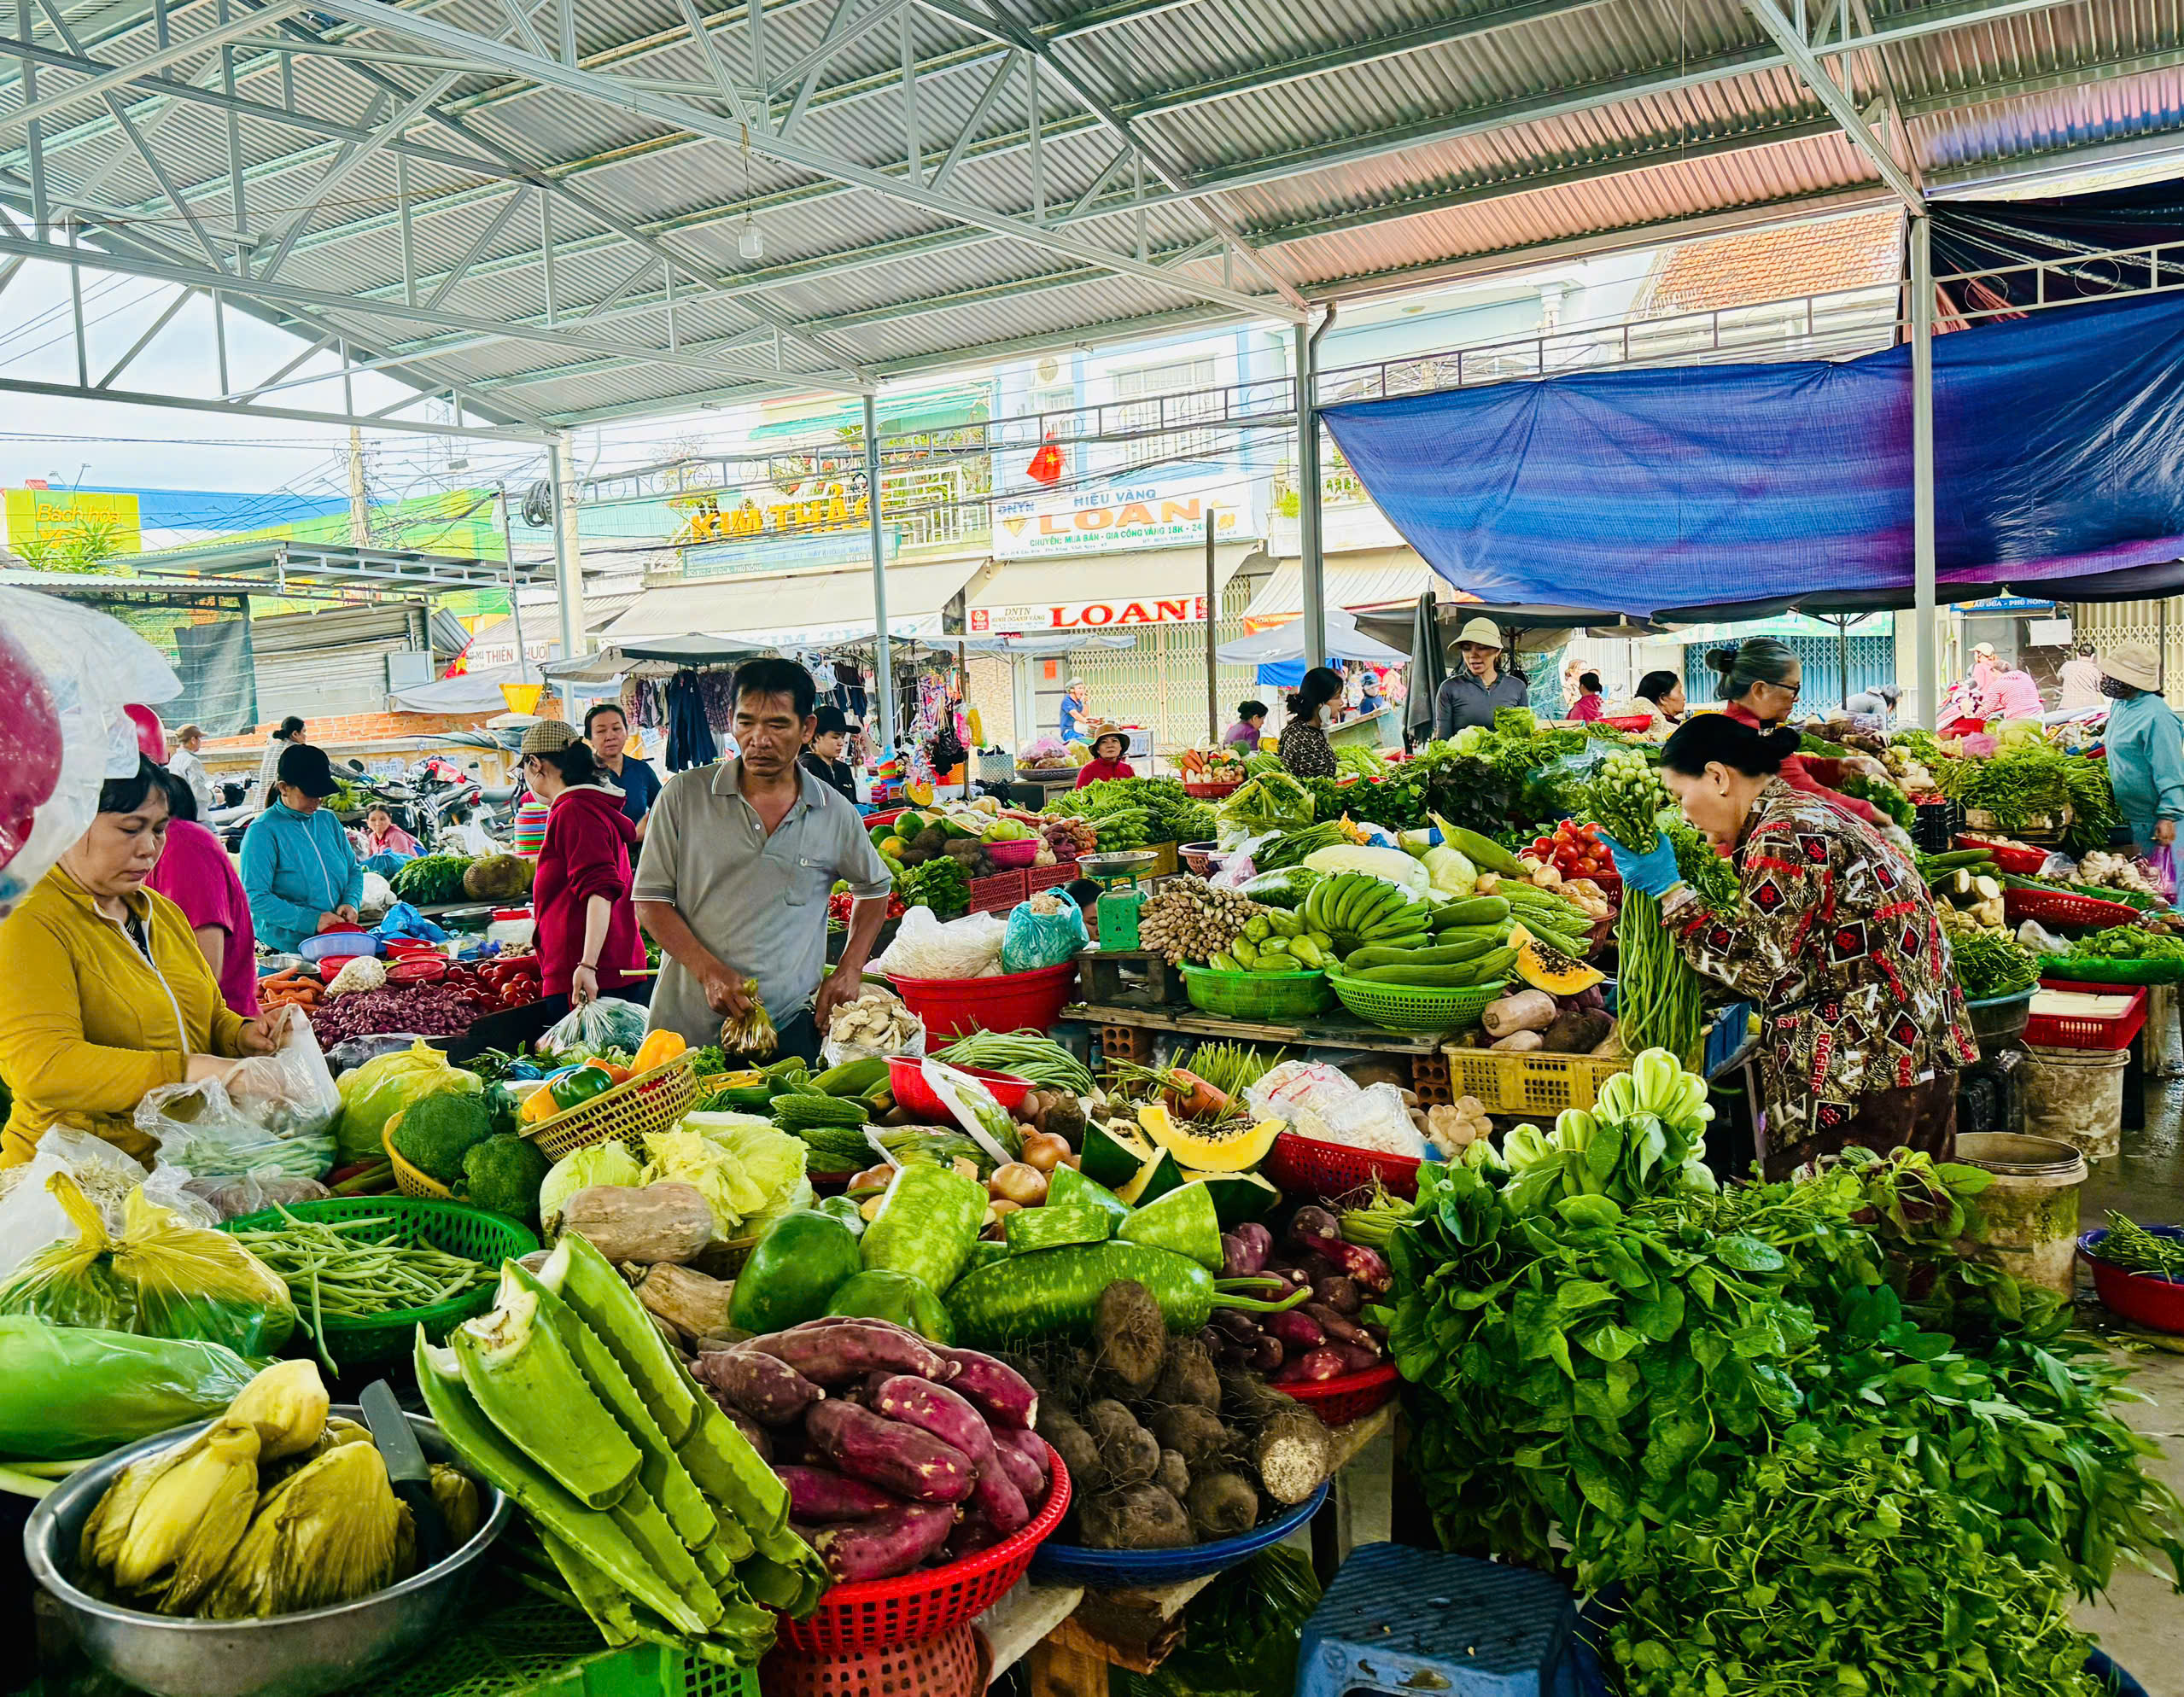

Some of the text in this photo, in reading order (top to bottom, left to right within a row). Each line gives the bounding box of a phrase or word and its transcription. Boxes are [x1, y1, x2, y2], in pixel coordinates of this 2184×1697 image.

[1074, 489, 1156, 507] HIỆU VÀNG
[36, 503, 120, 523] Bách hóa
[1039, 498, 1201, 535] LOAN
[691, 510, 763, 543] KIM
[1120, 528, 1143, 539] CÔNG
[1005, 607, 1031, 616] DNTN
[1048, 599, 1191, 627] LOAN
[486, 645, 513, 663] THIÊN
